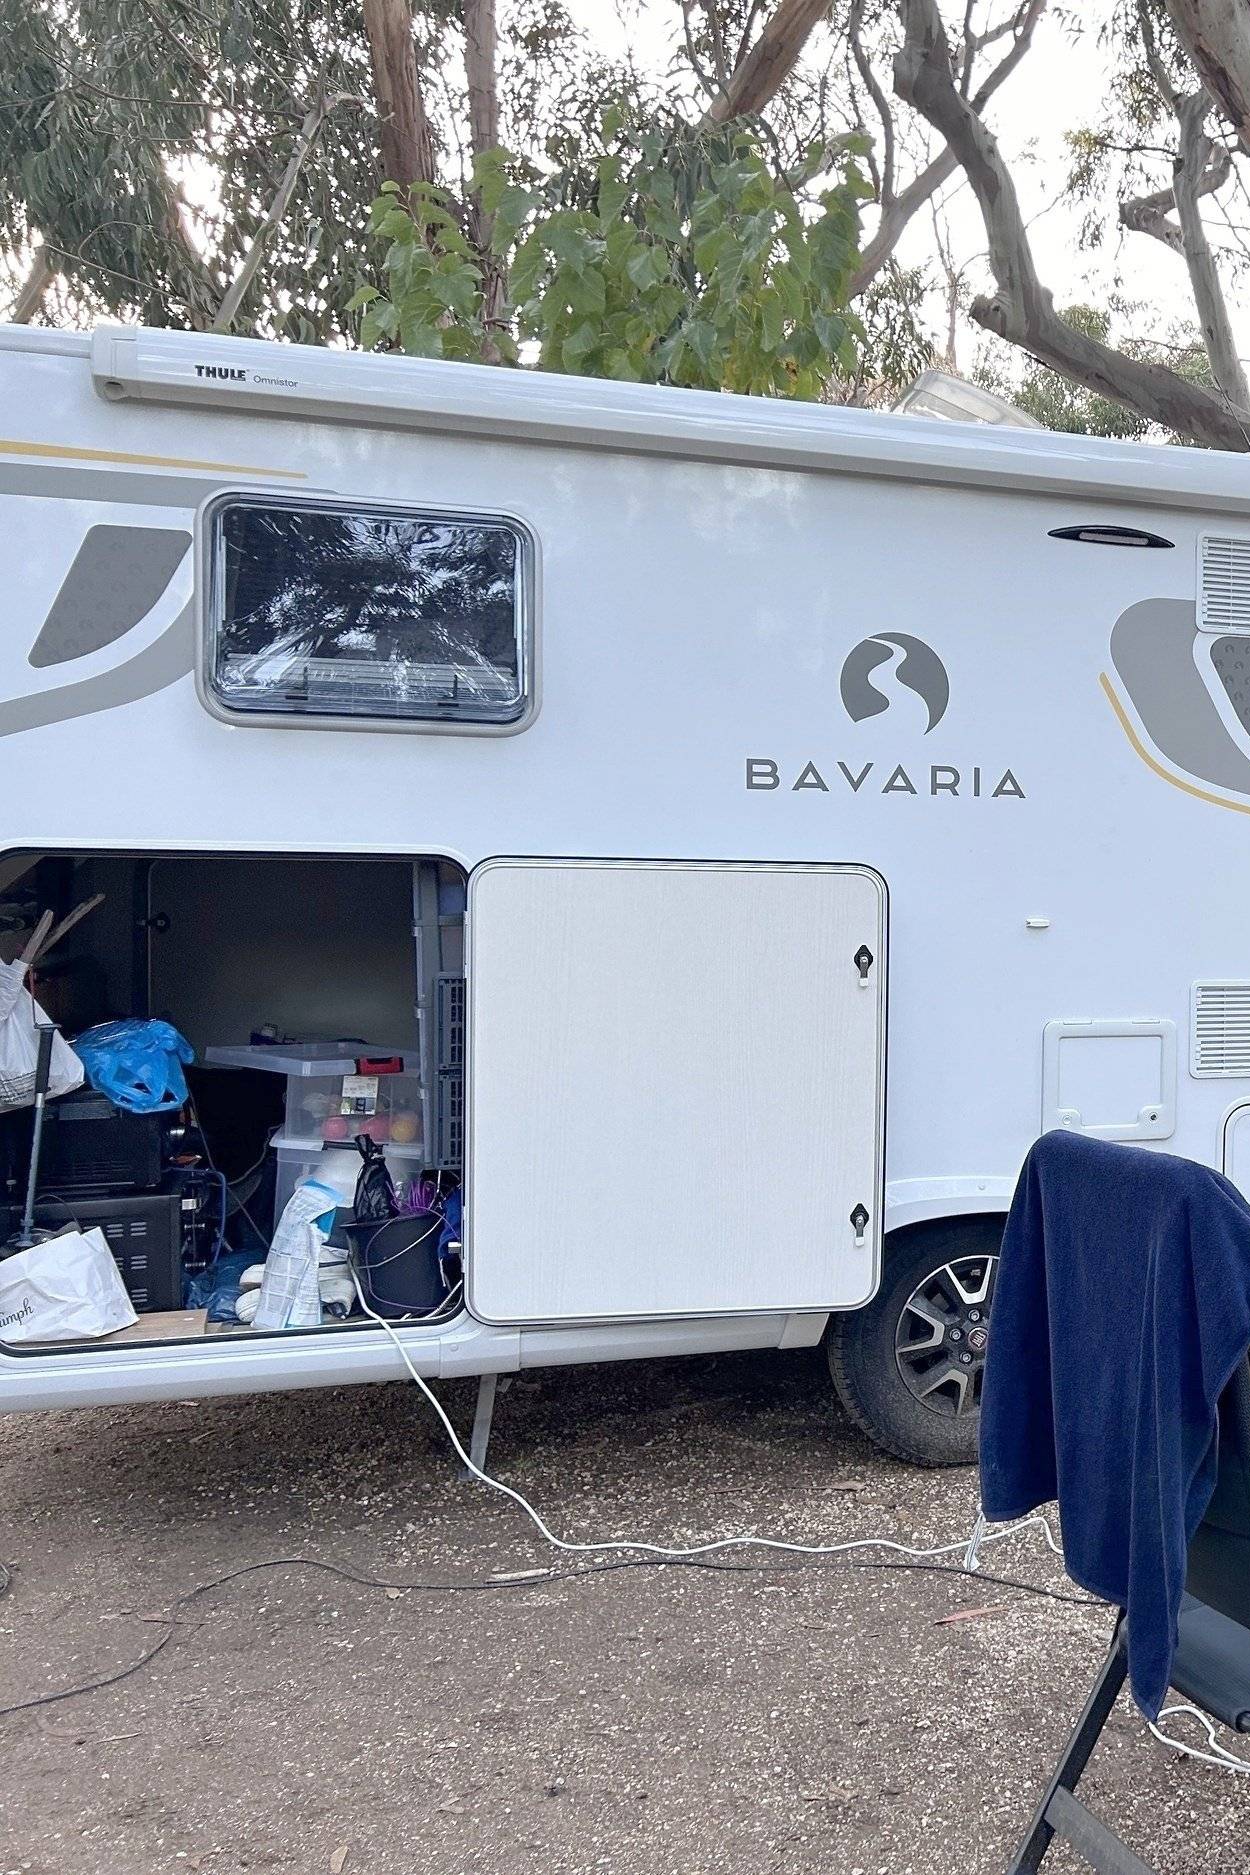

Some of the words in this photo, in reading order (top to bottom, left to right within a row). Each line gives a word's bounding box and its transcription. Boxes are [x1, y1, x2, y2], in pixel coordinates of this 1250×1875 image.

[194, 365, 246, 382] THULE
[253, 375, 299, 387] Omnistor
[746, 758, 1027, 799] BAVARIA
